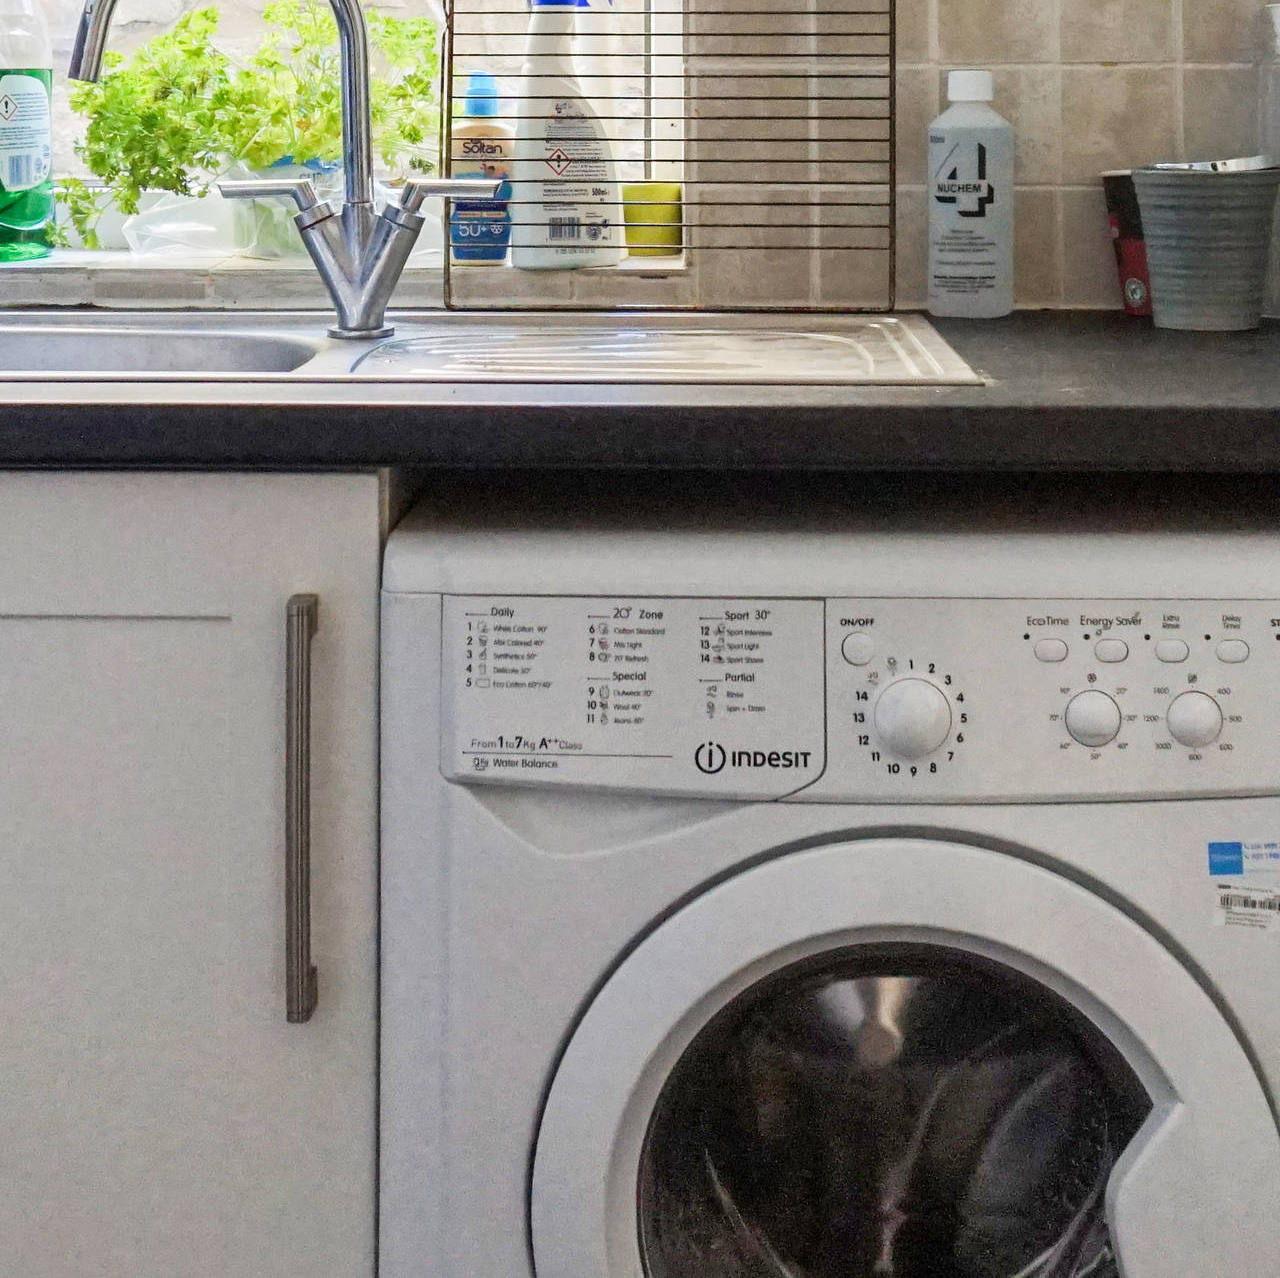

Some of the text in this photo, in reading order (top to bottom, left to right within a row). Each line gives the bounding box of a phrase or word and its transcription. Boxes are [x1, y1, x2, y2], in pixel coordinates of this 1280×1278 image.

[462, 140, 502, 155] Soltan
[937, 183, 982, 194] NUCHEM
[458, 223, 487, 237] 50+
[491, 607, 515, 618] Daily
[639, 609, 663, 620] Zone
[724, 610, 749, 622] Sport
[840, 618, 875, 626] ON/OFF
[1080, 615, 1143, 628] Energy Saver
[700, 626, 710, 636] 12
[700, 640, 710, 649] 13
[700, 654, 710, 663] 14
[909, 659, 914, 670] 1
[928, 663, 936, 674] 2
[612, 671, 647, 682] Special
[724, 672, 755, 683] Partial
[944, 675, 952, 685] 3
[856, 691, 868, 701] 14
[956, 693, 964, 702] 4
[587, 700, 597, 710] 10
[587, 714, 595, 723] 11
[853, 713, 865, 723] 13
[960, 713, 967, 723] 5
[858, 736, 869, 746] 12
[956, 733, 964, 743] 6
[871, 752, 880, 762] 11
[947, 751, 954, 761] 7
[493, 758, 558, 768] Water Balance
[930, 763, 937, 773] 8
[887, 763, 900, 774] 10
[910, 766, 917, 777] 9
